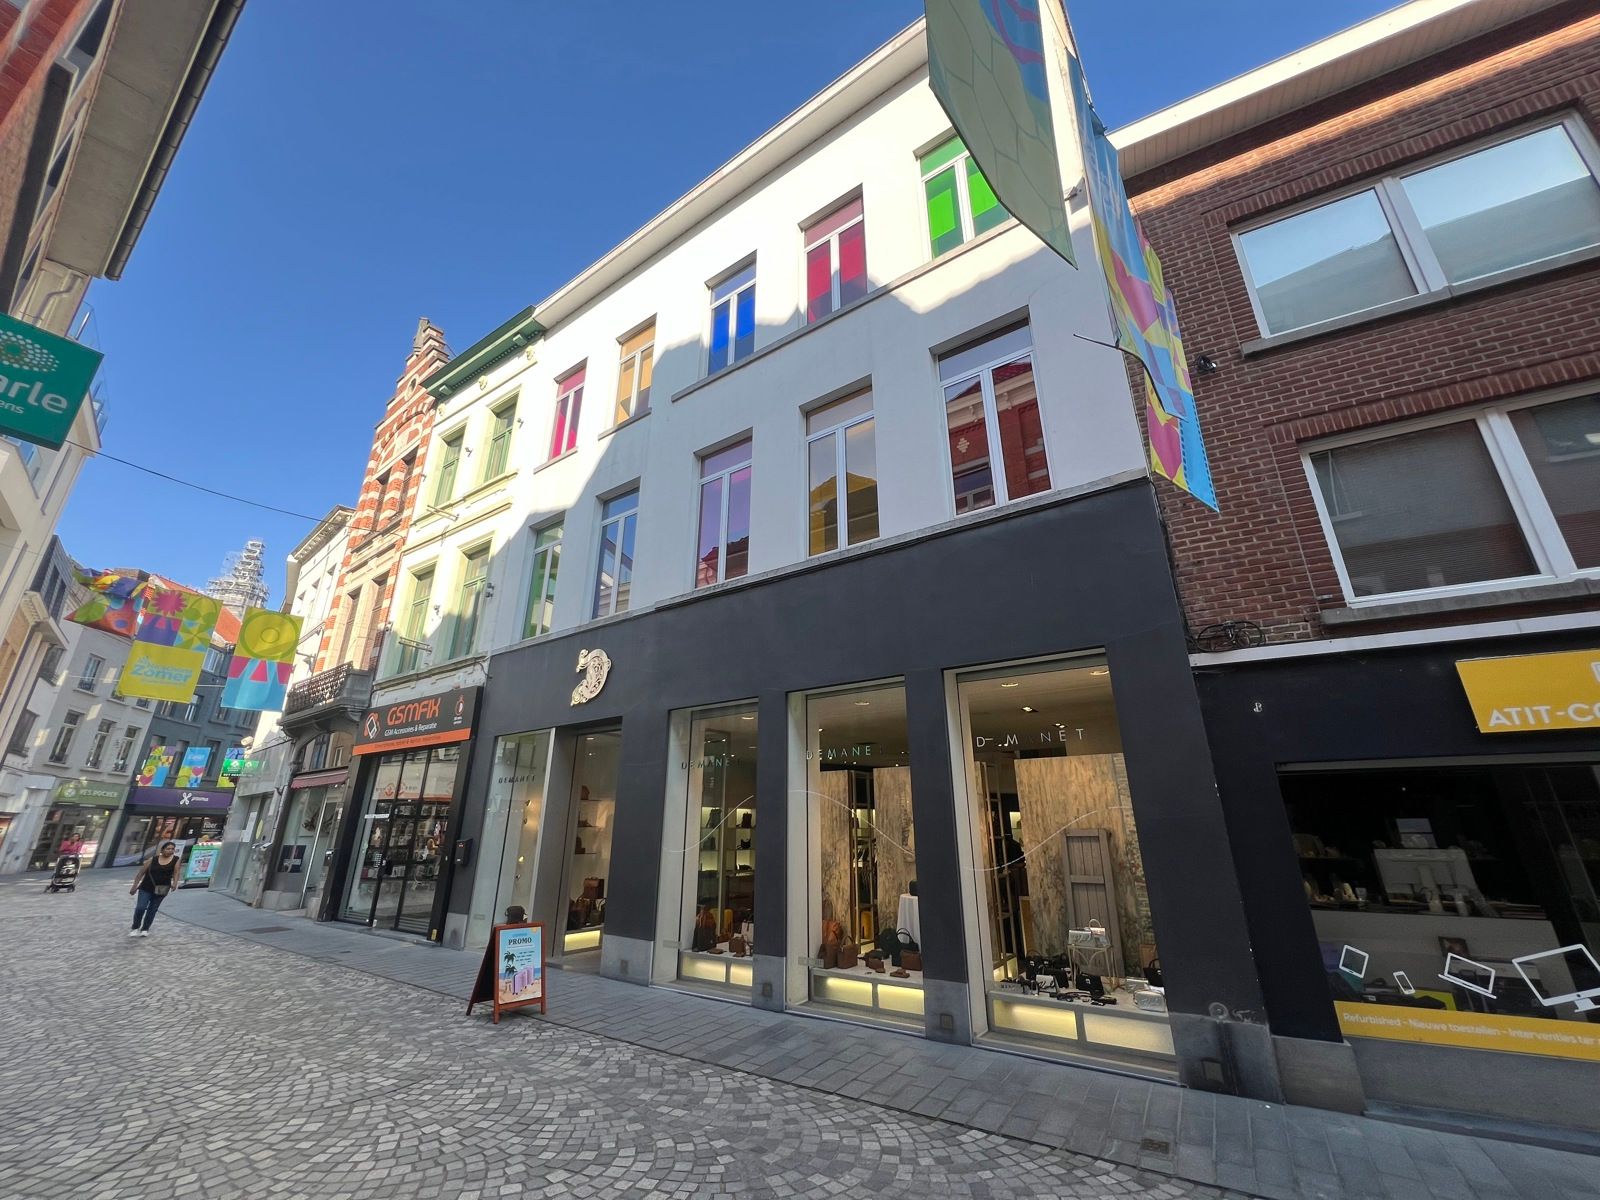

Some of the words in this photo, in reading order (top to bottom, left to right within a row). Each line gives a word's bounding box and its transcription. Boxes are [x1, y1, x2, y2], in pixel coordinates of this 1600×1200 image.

[130, 664, 193, 683] Zomer
[387, 697, 441, 726] GSMFIX
[384, 729, 394, 737] GSM
[498, 774, 536, 784] DEMANET
[508, 937, 532, 945] PROMO
[1343, 1013, 1401, 1026] Refurbished
[1408, 1018, 1447, 1031] Nieuwe
[1449, 1023, 1501, 1036] toestellen
[1507, 1028, 1577, 1043] Interventies
